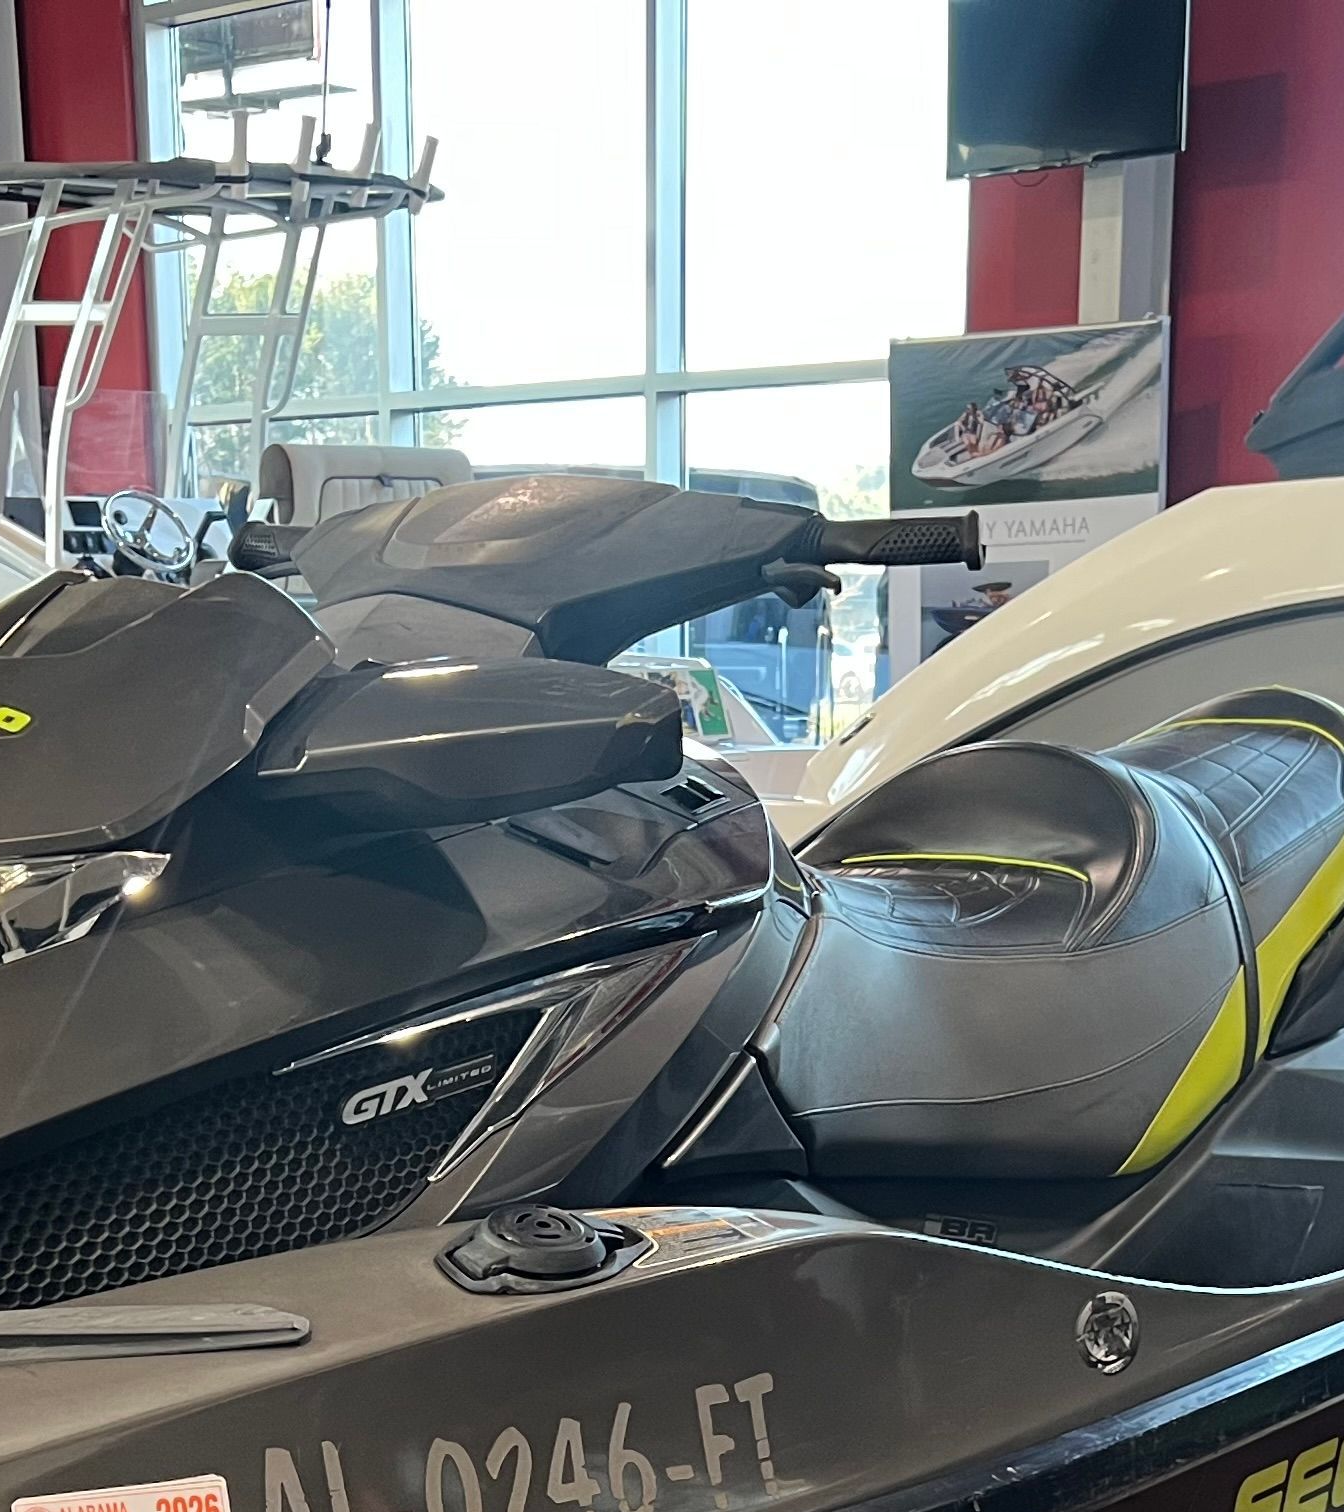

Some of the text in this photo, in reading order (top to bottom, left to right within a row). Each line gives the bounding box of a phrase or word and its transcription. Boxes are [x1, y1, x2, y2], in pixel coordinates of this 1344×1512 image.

[1004, 516, 1090, 538] YAMAHA
[342, 1065, 492, 1125] GTX LIMITED
